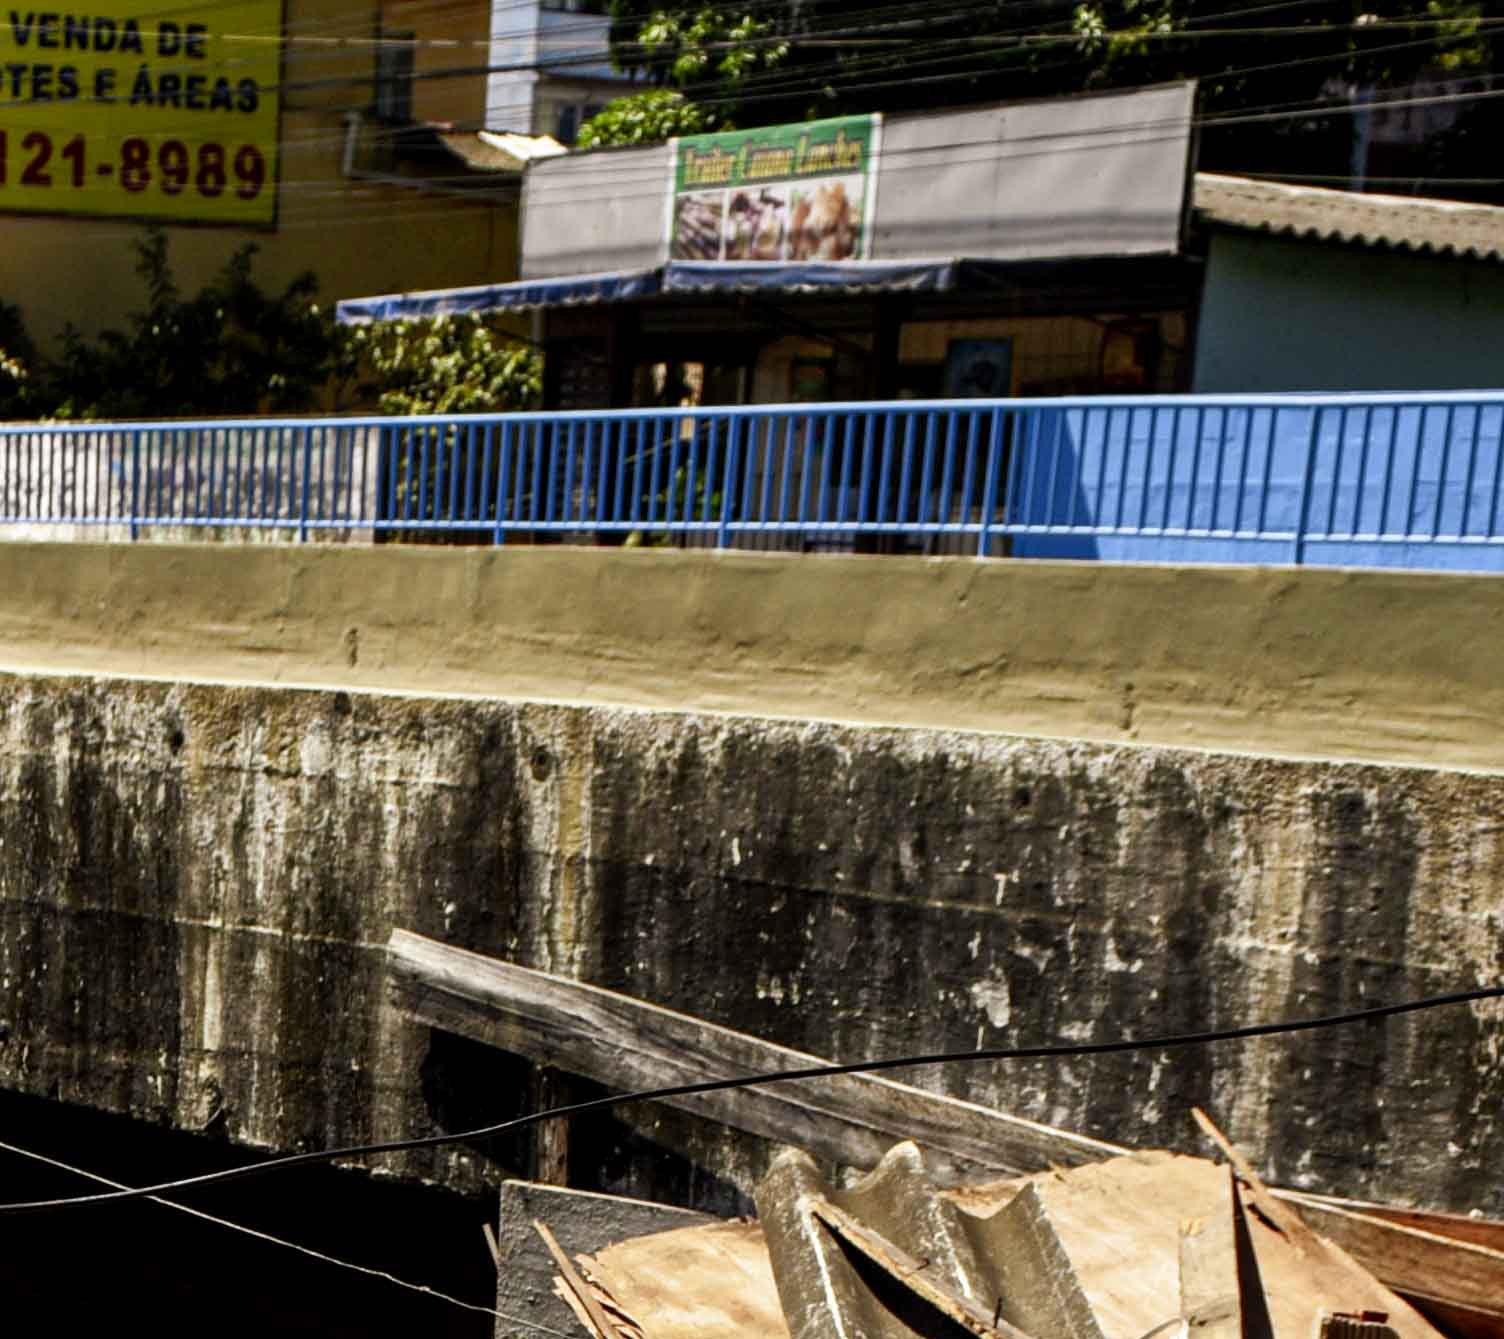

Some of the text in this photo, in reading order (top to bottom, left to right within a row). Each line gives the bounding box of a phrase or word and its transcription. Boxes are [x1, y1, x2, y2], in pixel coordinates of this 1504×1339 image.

[10, 11, 209, 60] VENDA DE
[95, 68, 118, 103] E
[130, 64, 260, 114] ÁREAS
